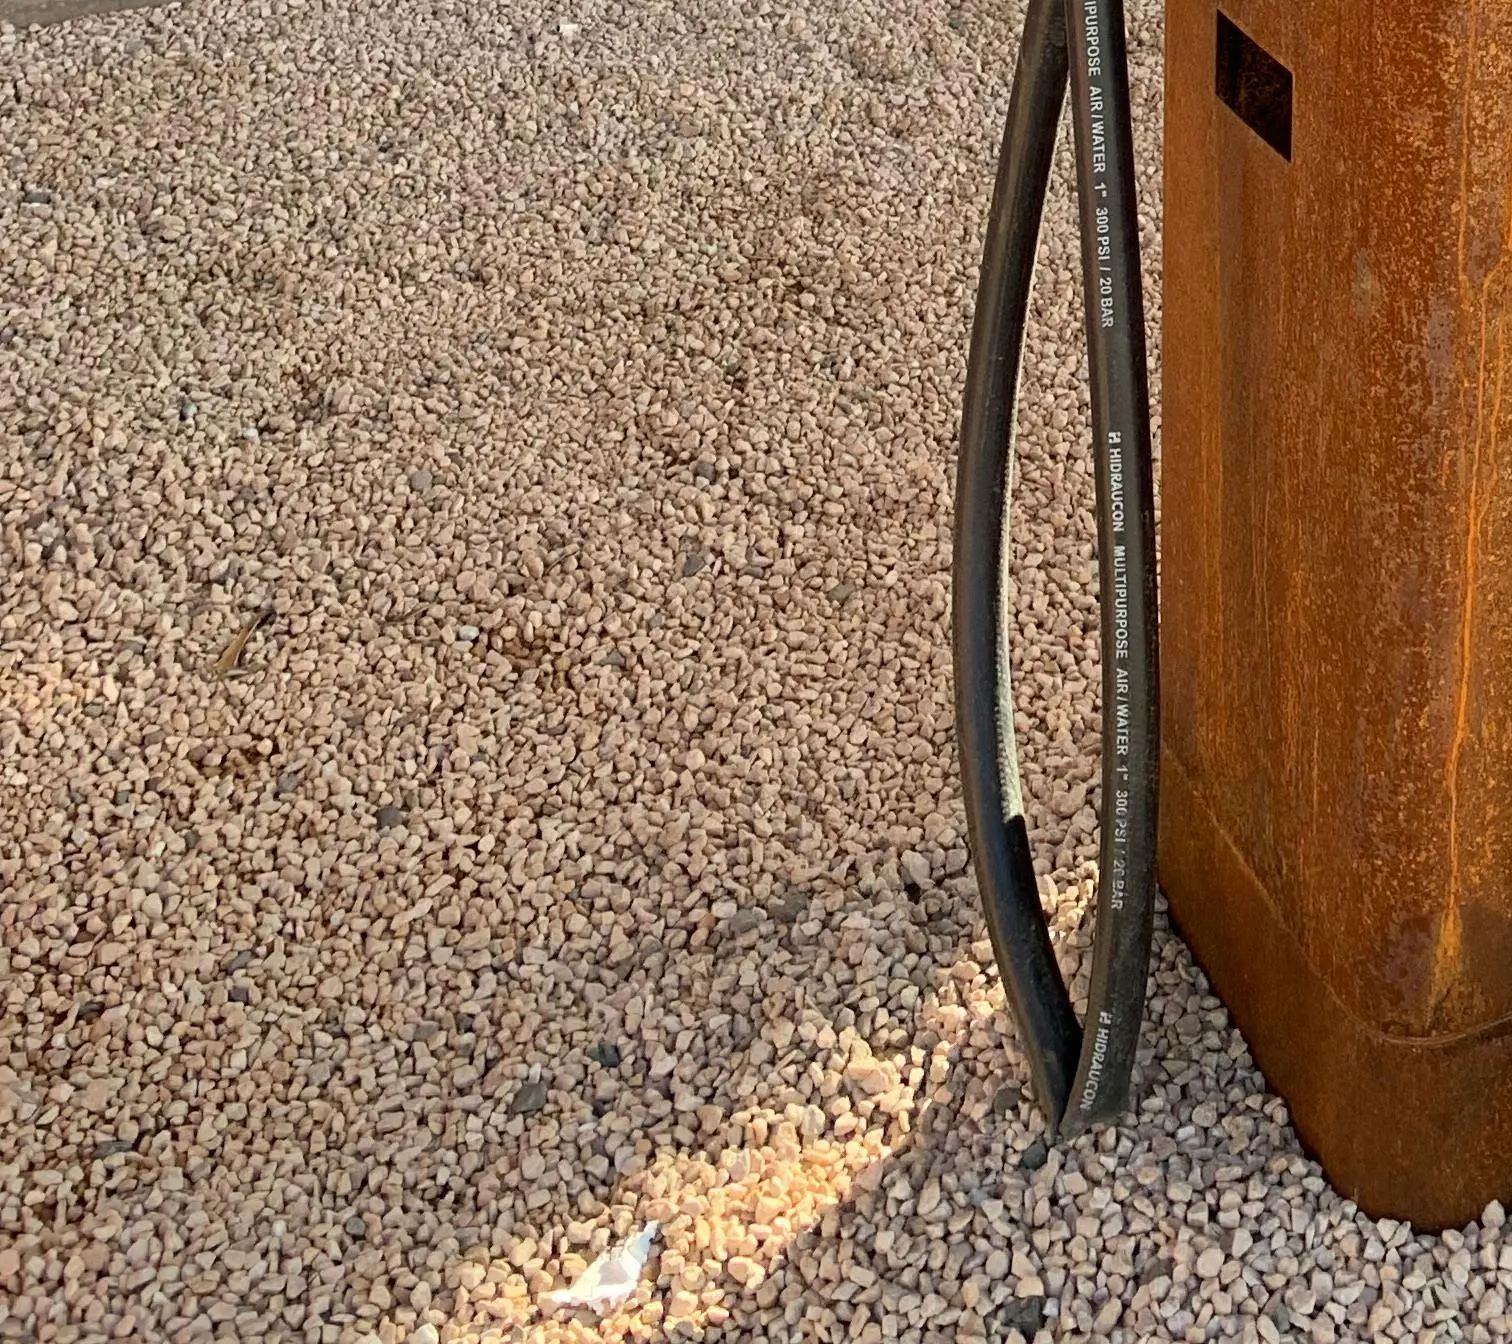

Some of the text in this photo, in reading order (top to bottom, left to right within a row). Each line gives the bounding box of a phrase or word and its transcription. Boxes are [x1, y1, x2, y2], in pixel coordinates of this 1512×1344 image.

[1097, 235, 1111, 261] PSI
[1101, 296, 1115, 328] BAR
[1108, 447, 1125, 533] HIDRAUCON
[1112, 544, 1129, 660] MULTIPURPOSE
[1080, 1027, 1110, 1111] HIDRAUCON
